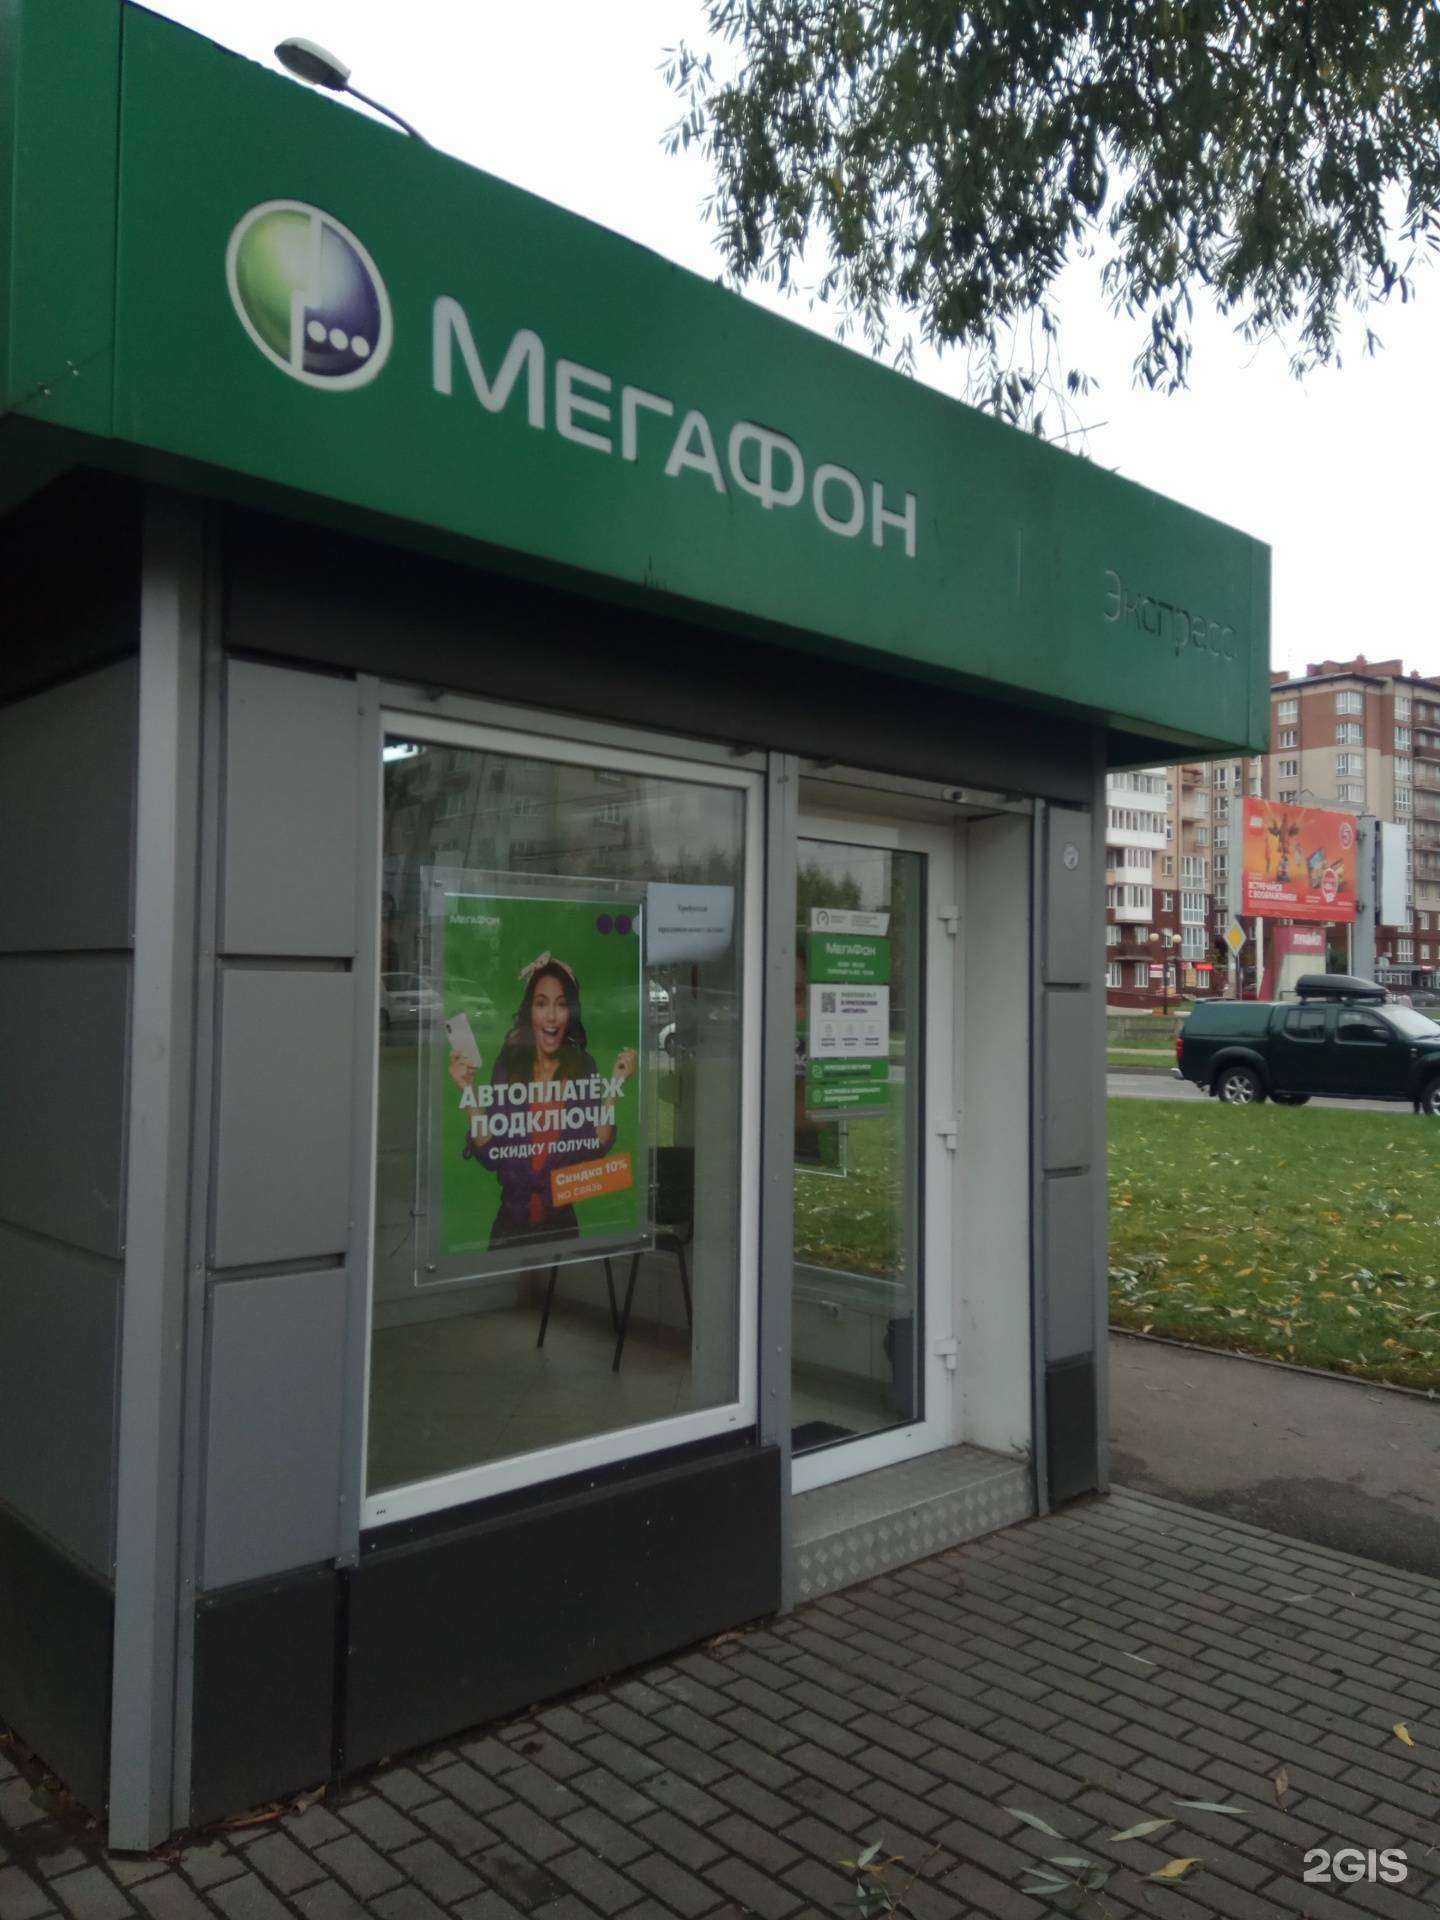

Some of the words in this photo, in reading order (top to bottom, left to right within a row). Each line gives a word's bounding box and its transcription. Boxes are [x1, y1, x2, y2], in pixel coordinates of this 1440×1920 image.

[459, 1074, 625, 1109] АВТОПЛАТЁЖ
[470, 1104, 615, 1138] ПОДКЛЮЧИ
[488, 1142, 545, 1160] СКИДКУ
[548, 1137, 600, 1154] ПОЛУЧИ
[556, 1168, 603, 1186] Скидка
[606, 1158, 628, 1175] 10%
